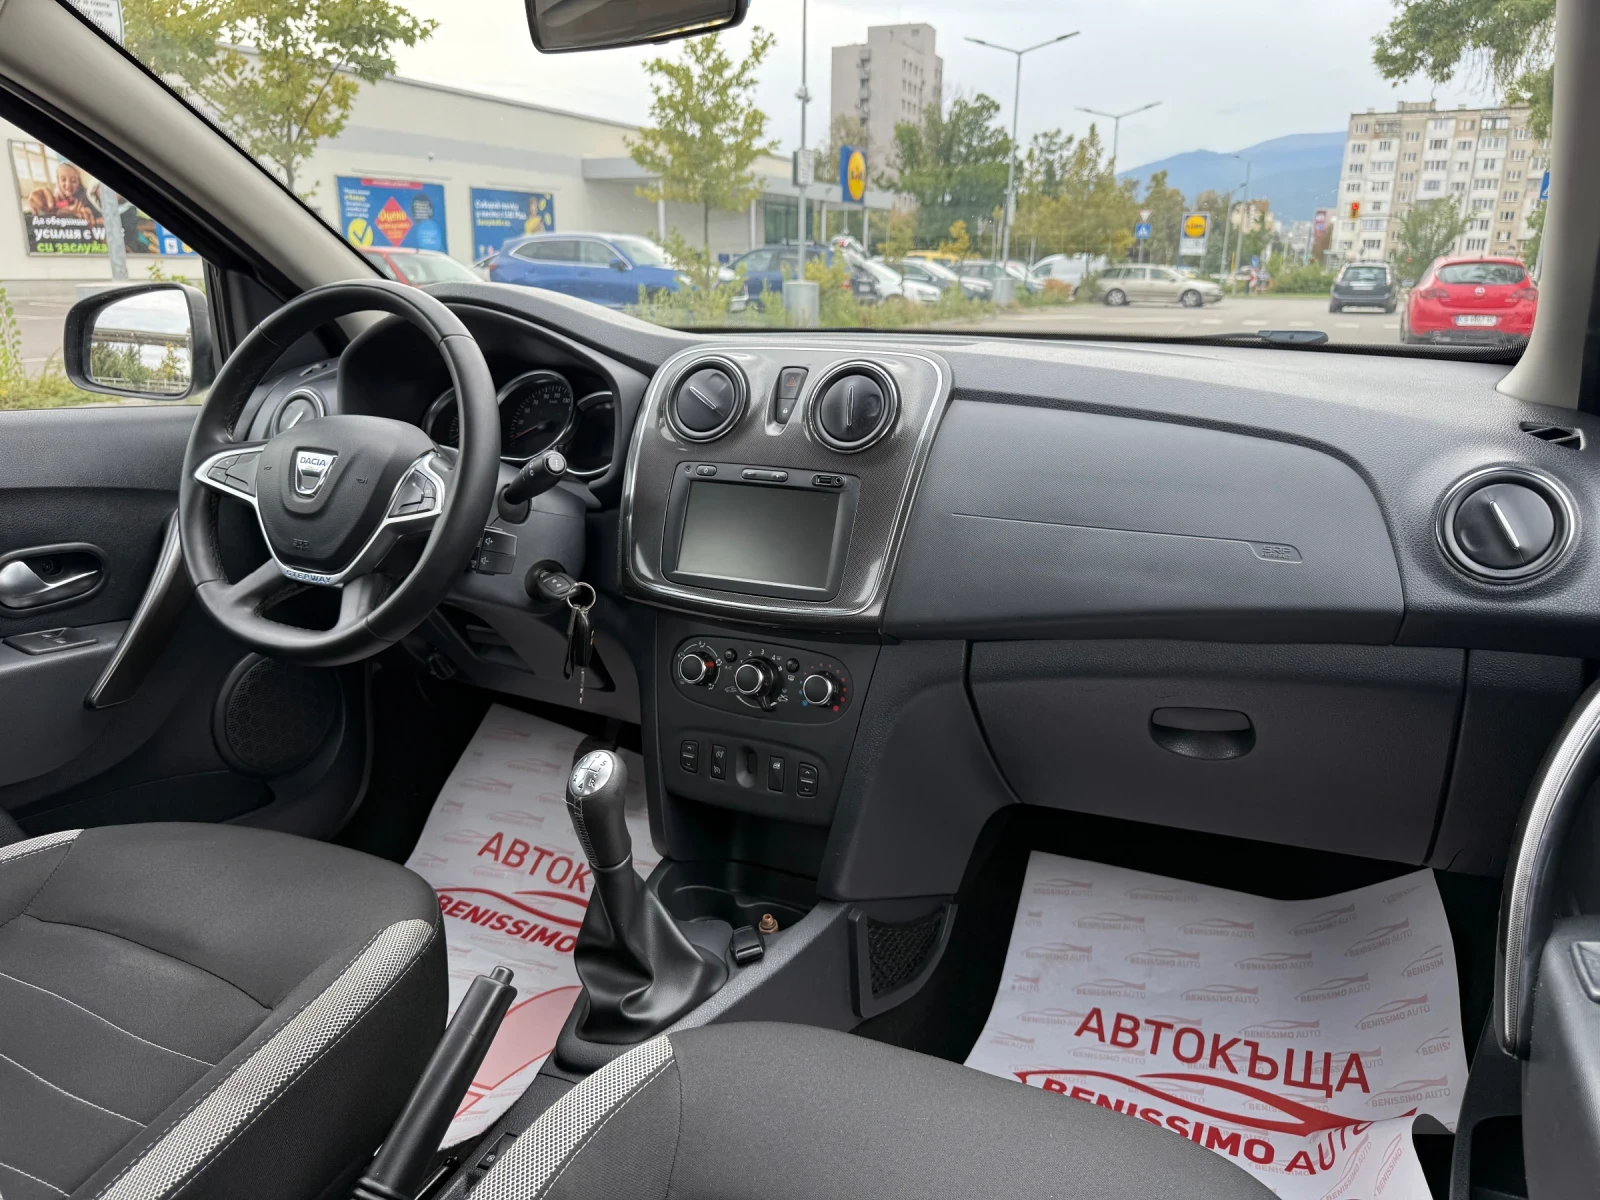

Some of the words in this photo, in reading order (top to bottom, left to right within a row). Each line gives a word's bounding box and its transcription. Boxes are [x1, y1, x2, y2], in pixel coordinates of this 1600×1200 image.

[32, 215, 45, 226] Да
[34, 228, 81, 241] усилия
[83, 229, 92, 239] с
[37, 242, 54, 252] си
[300, 456, 327, 467] DACIA
[285, 568, 331, 584] STEPWAY
[437, 893, 576, 953] BENISSIMO
[1294, 920, 1337, 936] BENISSIMO
[1338, 913, 1358, 925] AUTO
[1183, 927, 1229, 937] BENISSIMO
[1231, 930, 1255, 938] AUTO
[1350, 938, 1391, 957] BENISSIMO
[1392, 928, 1413, 942] AUTO
[1130, 956, 1175, 967] BENISSIMO
[1176, 958, 1200, 968] AUTO
[1240, 962, 1287, 970] BENISSIMO
[1289, 960, 1314, 969] AUTO
[1406, 957, 1444, 977] BENISSIM
[1076, 987, 1122, 997] BENISSIMO
[1123, 990, 1147, 999] AUTO
[1185, 993, 1233, 1003] BENISSIMO
[1234, 995, 1260, 1004] AUTO
[1300, 989, 1347, 1003] BENISSIMO
[1348, 982, 1371, 994] AUTO
[1361, 1011, 1405, 1030] BENISSIMO
[1406, 1004, 1430, 1016] AUTO
[1244, 1030, 1294, 1039] BENISSIMO
[1295, 1029, 1321, 1039] AUTO
[1072, 1049, 1120, 1062] BENISSIMO
[1121, 1053, 1146, 1065] AUTO
[1074, 1007, 1371, 1098] АВТОКЪЩА
[1371, 1090, 1423, 1108] BENISSIMO
[1424, 1087, 1451, 1100] AUTO
[1325, 1163, 1360, 1200] BENISSIMO
[1359, 1141, 1372, 1164] AUTO
[1376, 1147, 1403, 1195] BENISSIMO
